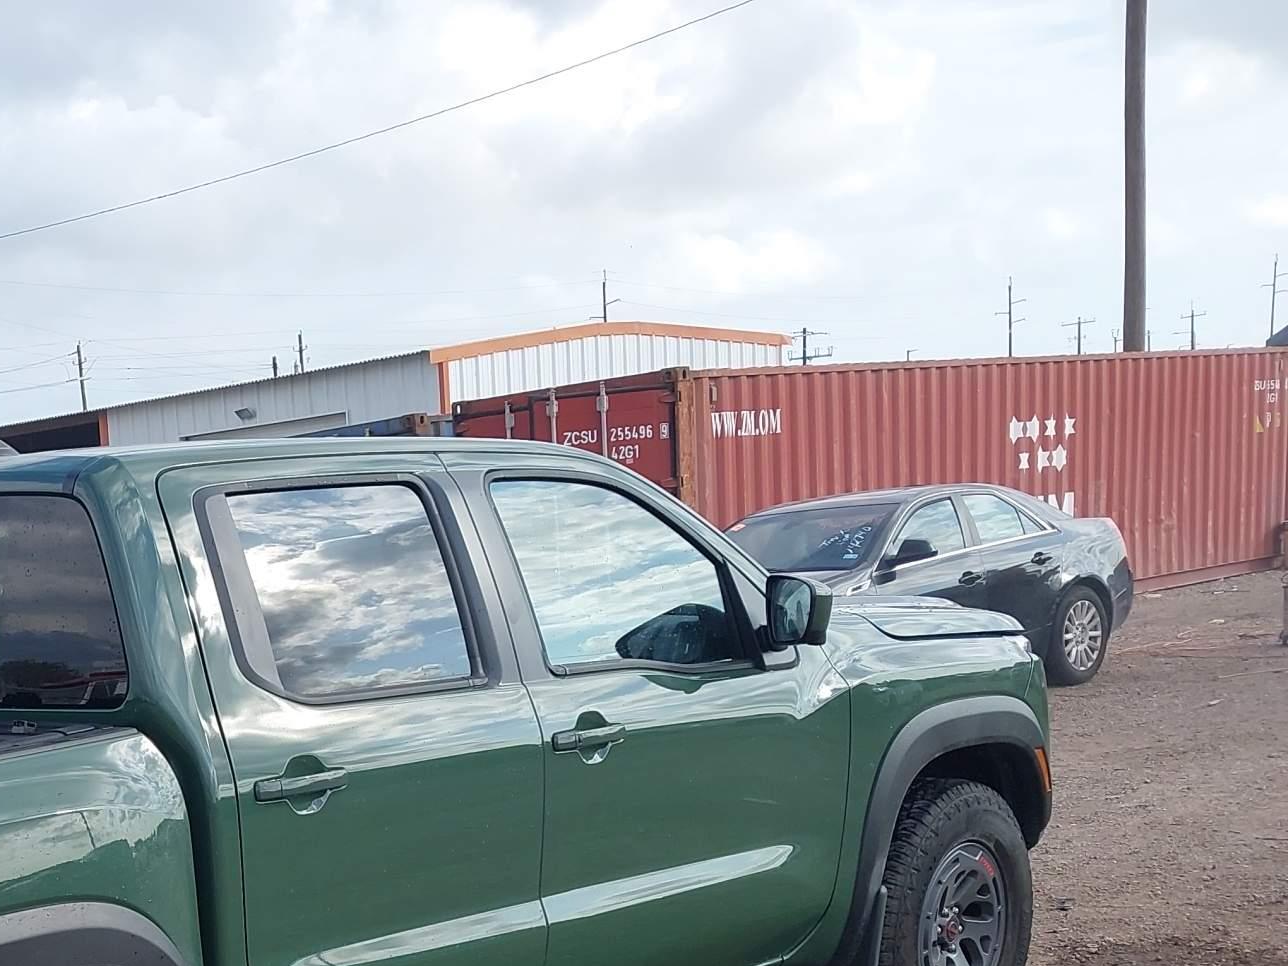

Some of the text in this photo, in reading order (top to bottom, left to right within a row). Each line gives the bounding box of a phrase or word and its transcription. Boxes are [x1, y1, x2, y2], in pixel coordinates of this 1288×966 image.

[563, 430, 597, 446] ZCSU
[610, 424, 653, 441] 255496
[612, 444, 639, 460] 42G1
